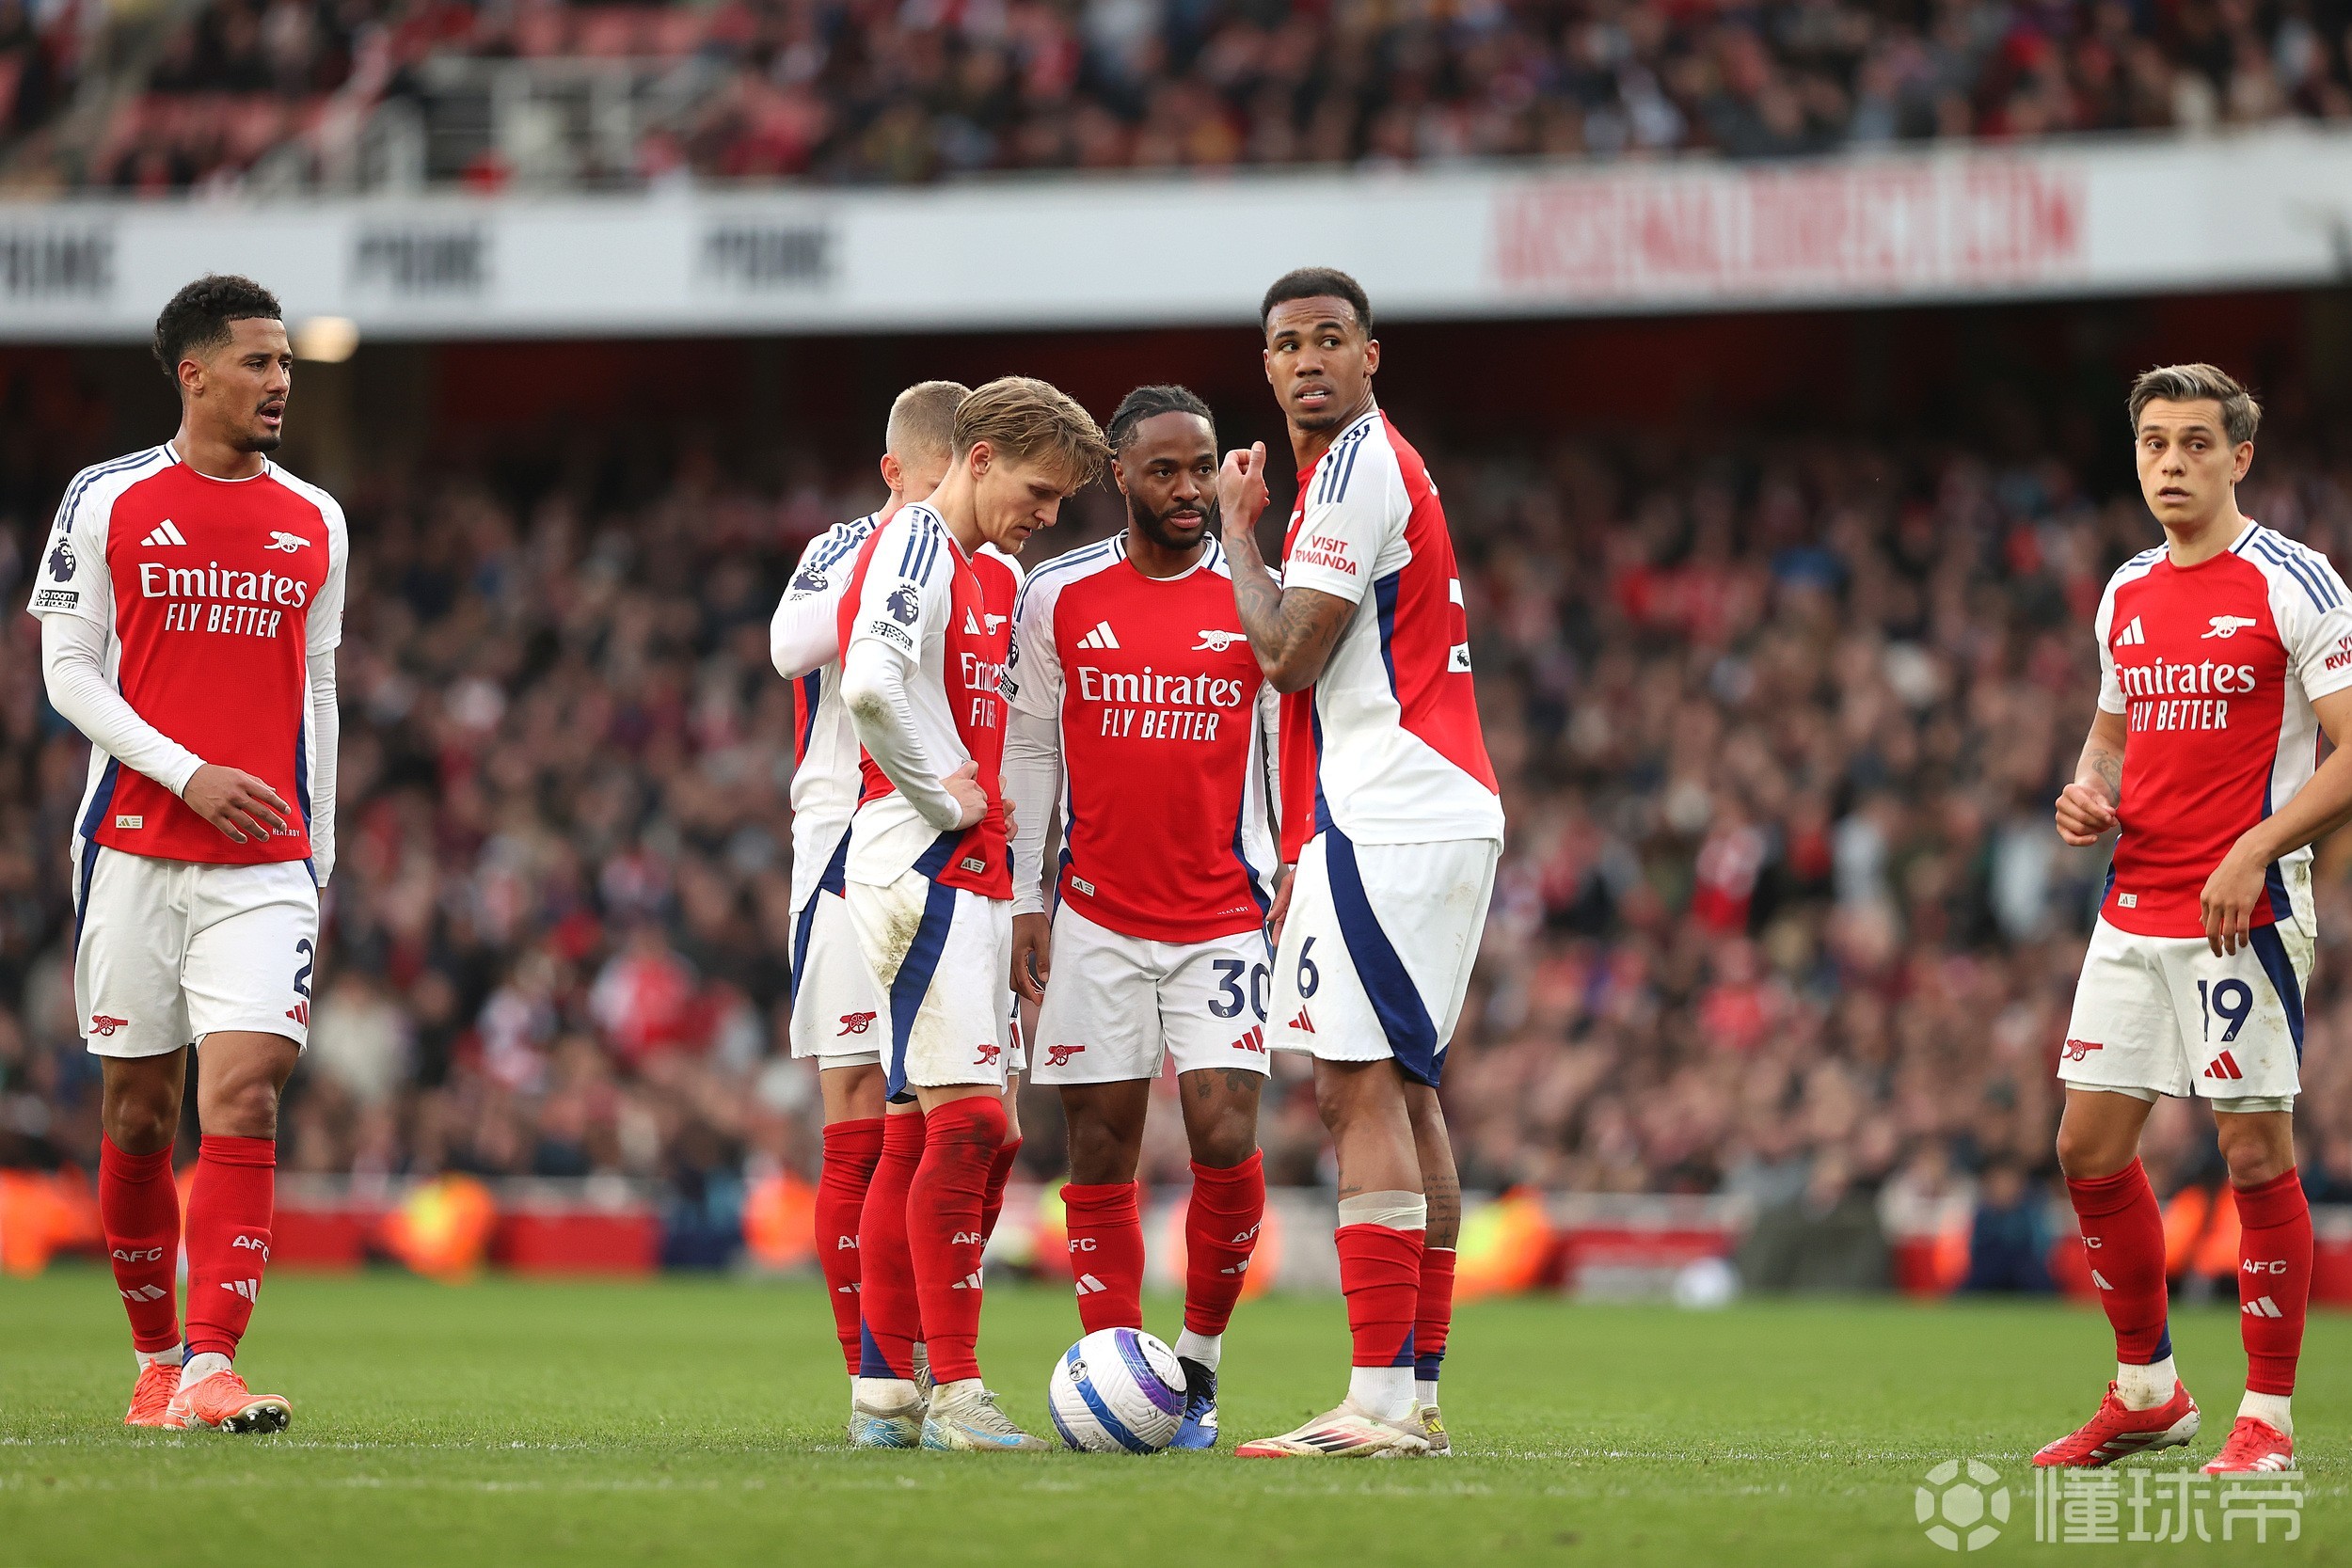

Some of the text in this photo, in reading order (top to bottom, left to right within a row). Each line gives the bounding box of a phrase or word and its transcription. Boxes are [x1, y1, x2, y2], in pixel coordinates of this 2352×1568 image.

[1311, 534, 1348, 555] VISIT
[1295, 549, 1358, 576] RWANDA
[137, 561, 308, 609] Emirates
[165, 603, 282, 639] FLY BETTER
[1076, 666, 1243, 707] Emirates
[1101, 707, 1220, 741] FLY BETTER
[2131, 699, 2229, 733] FLY BETTER
[294, 938, 313, 1000] 2
[1296, 935, 1320, 999] 6
[1207, 958, 1271, 1024] 30
[2197, 978, 2254, 1042] 19
[951, 1231, 980, 1245] AF
[1232, 1220, 1263, 1243] AF
[113, 1246, 163, 1263] AFC
[2242, 1258, 2287, 1275] AFC
